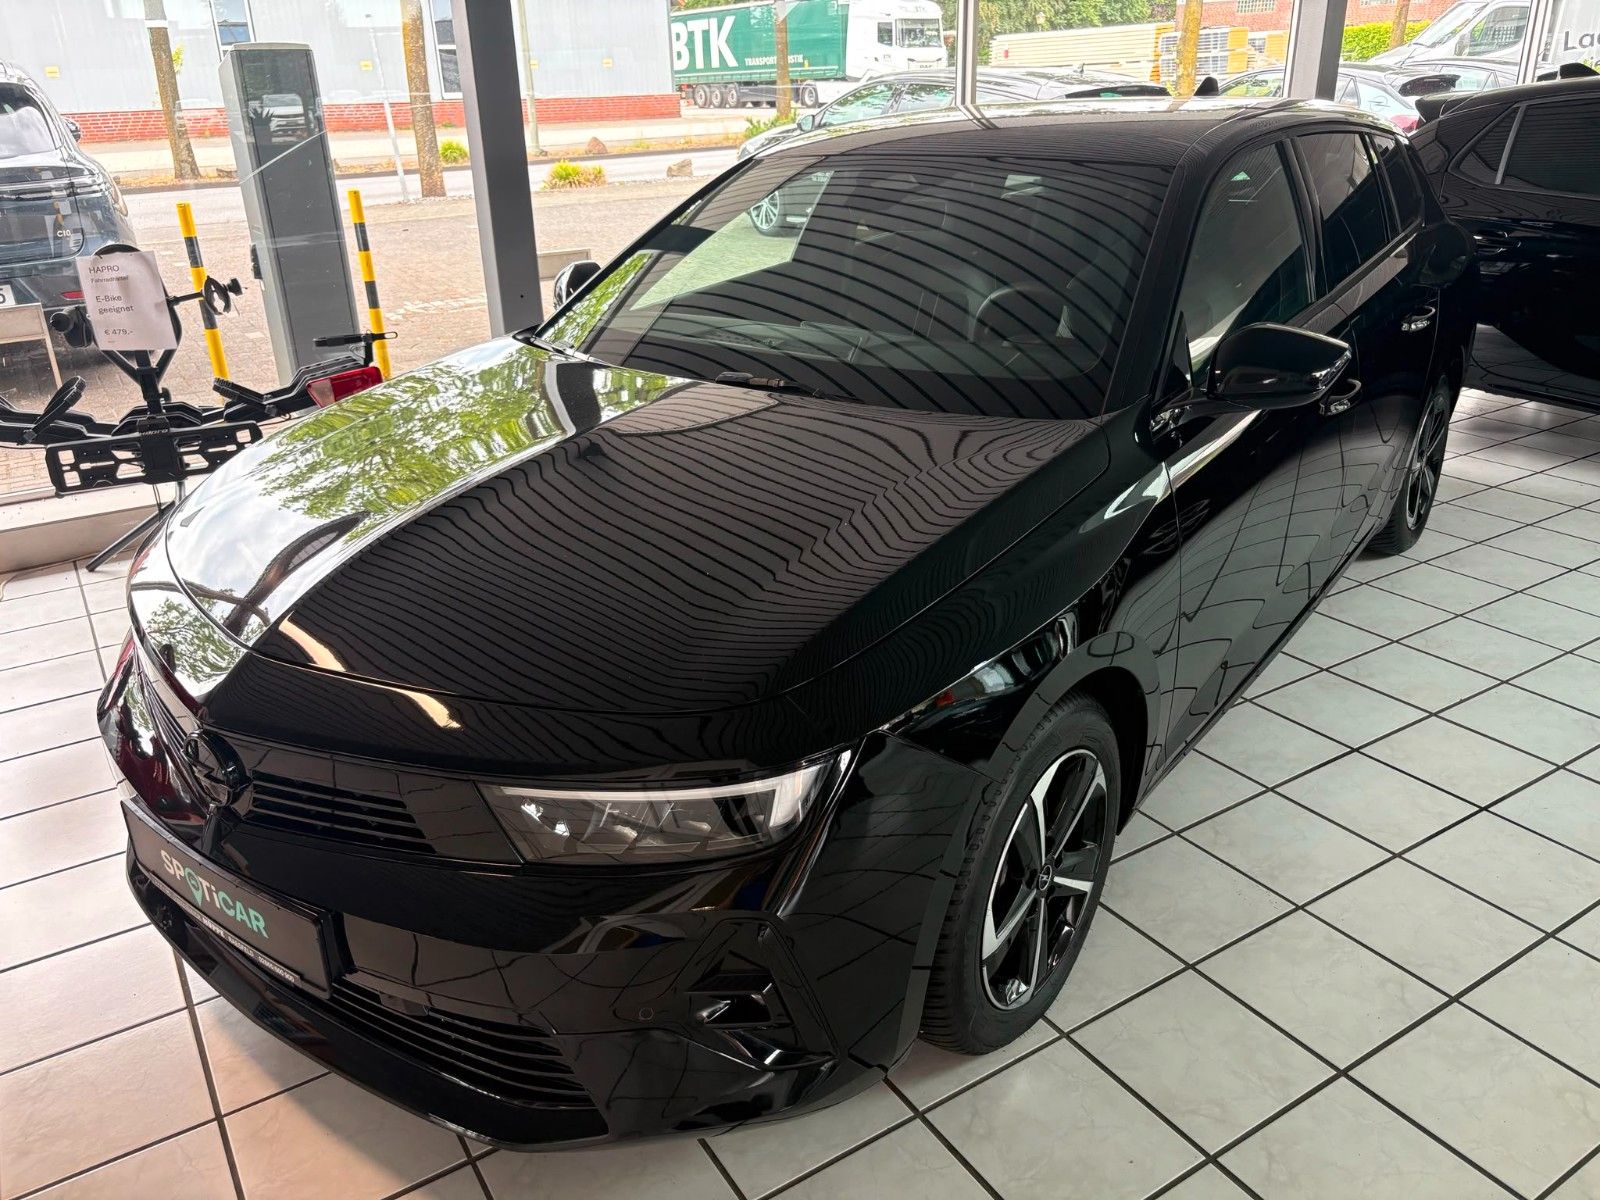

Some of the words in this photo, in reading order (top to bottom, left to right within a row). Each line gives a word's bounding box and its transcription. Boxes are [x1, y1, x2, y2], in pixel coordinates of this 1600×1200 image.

[671, 15, 739, 71] BTK
[56, 229, 72, 238] C10
[88, 264, 120, 274] HAPRO
[95, 295, 122, 303] E-Bike
[98, 305, 134, 315] geeignet
